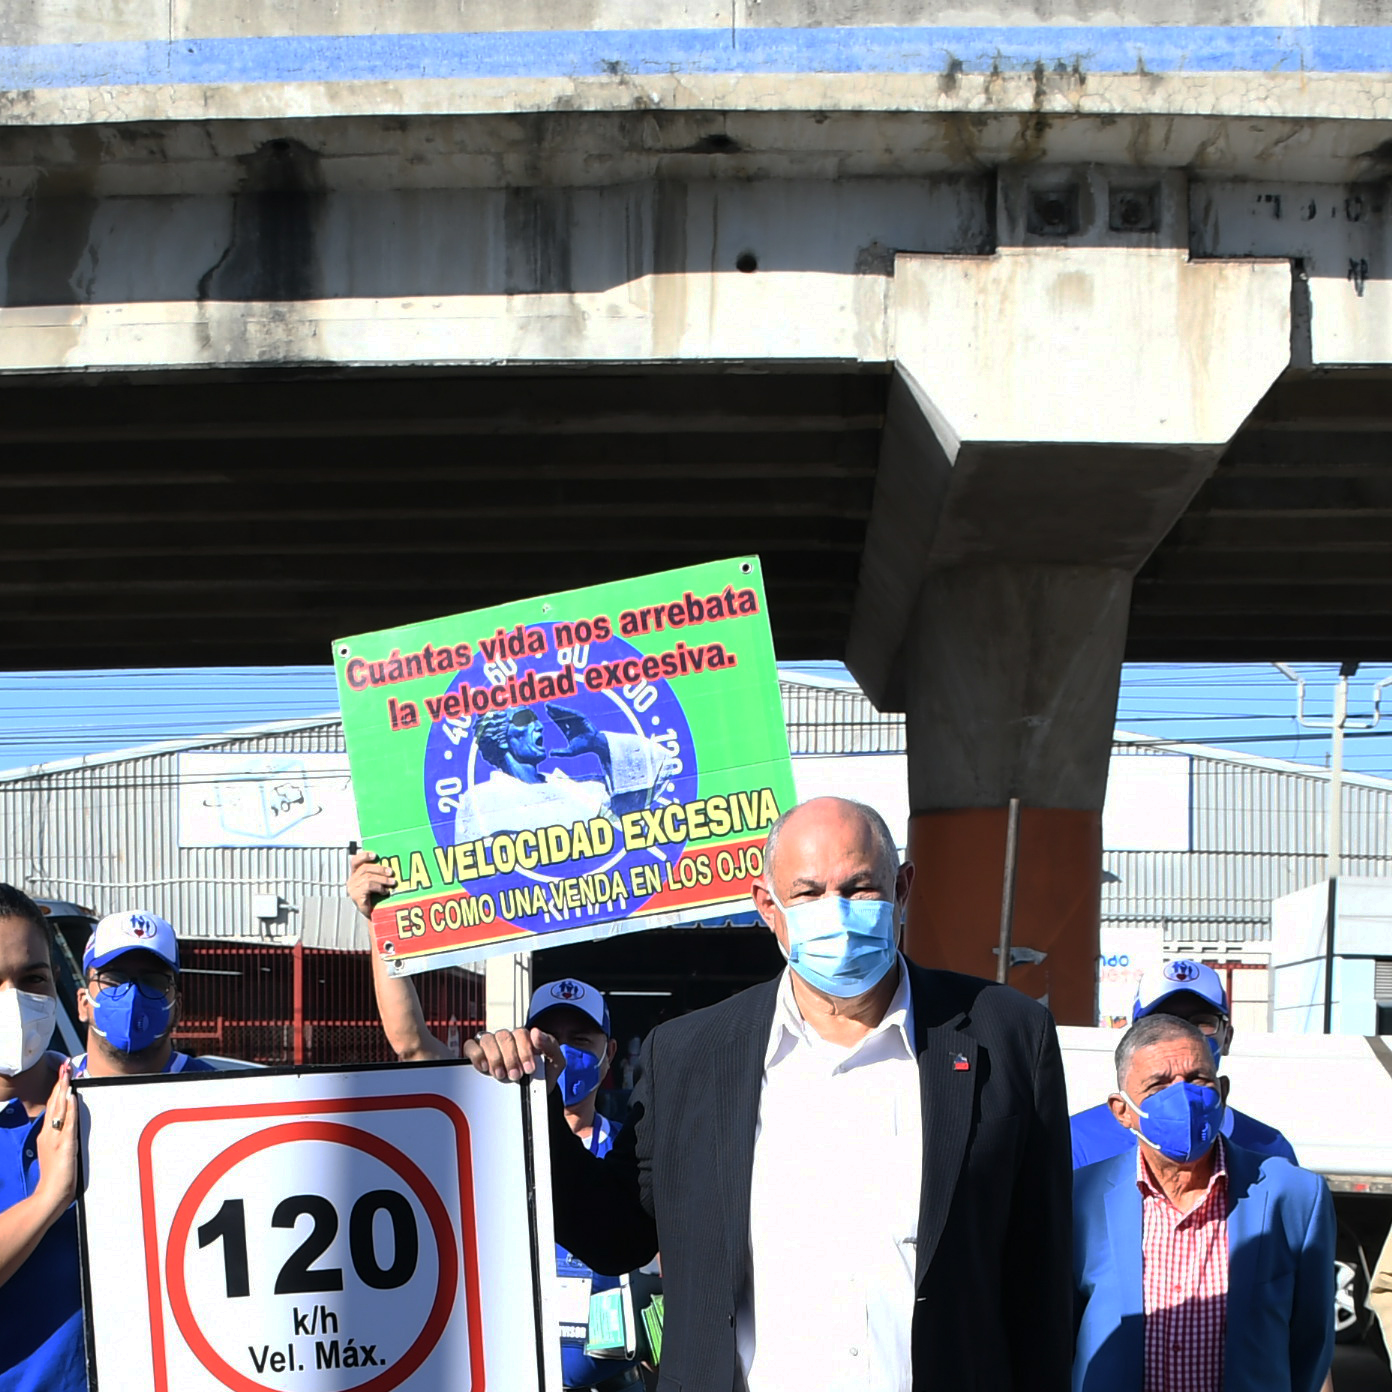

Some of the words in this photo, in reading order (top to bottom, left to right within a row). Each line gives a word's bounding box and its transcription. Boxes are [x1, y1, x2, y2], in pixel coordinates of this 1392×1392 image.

[346, 642, 474, 691] Cuántas
[479, 624, 548, 663] vida
[554, 615, 612, 649] nos
[619, 584, 760, 637] arrebata
[388, 697, 419, 731] la
[424, 664, 577, 721] velocidad
[584, 641, 738, 692] excesiva.
[433, 817, 615, 884] VELOCIDAD
[621, 788, 781, 850] EXCESIVA
[435, 776, 465, 814] 20
[395, 906, 426, 939] ES
[429, 893, 496, 933] COMO
[499, 885, 549, 921] UNA
[548, 870, 628, 910] VENDA
[629, 863, 663, 897] EN
[665, 854, 713, 891] LOS
[716, 845, 767, 882] OJO
[198, 1189, 419, 1298] 120
[248, 1343, 305, 1374] Vel.
[315, 1338, 387, 1370] Máx.
[293, 1305, 339, 1335] k/h
